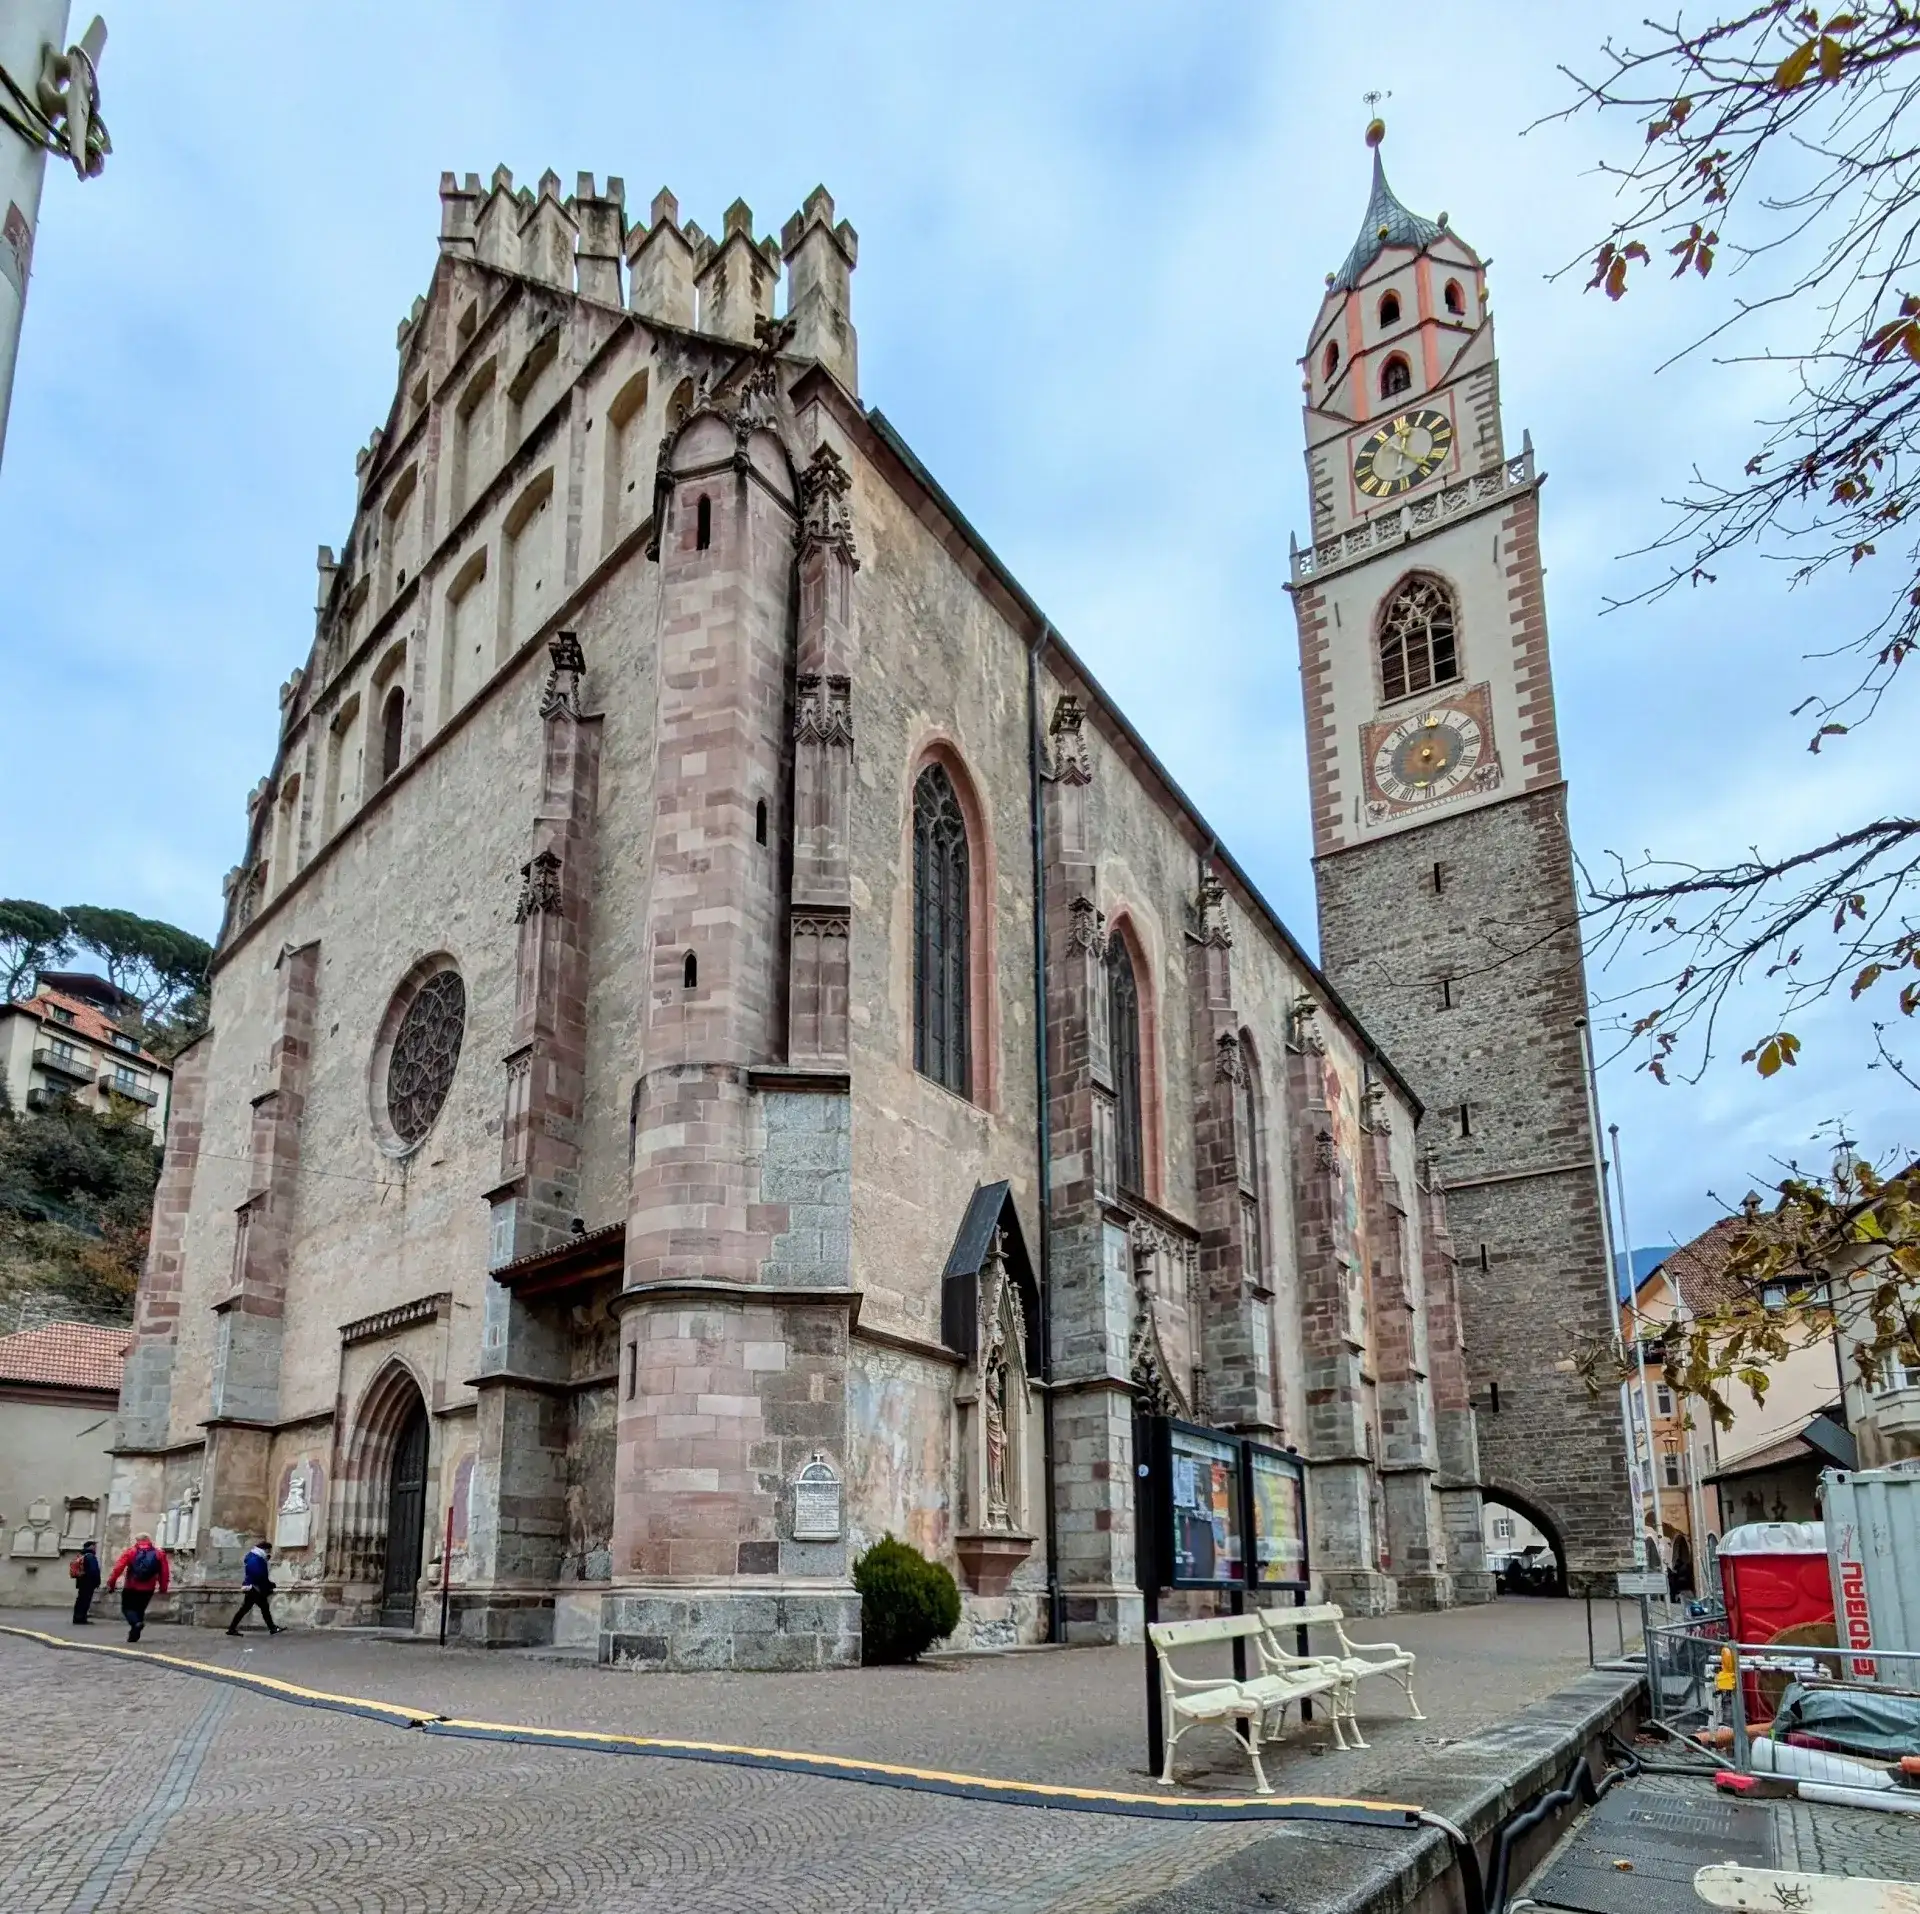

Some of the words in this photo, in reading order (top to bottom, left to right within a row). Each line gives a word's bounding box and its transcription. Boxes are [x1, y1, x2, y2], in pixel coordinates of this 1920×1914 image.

[1442, 710, 1451, 724] I
[1456, 718, 1472, 731] II
[1464, 734, 1480, 748] III
[1840, 1561, 1876, 1676] ERDBAU
